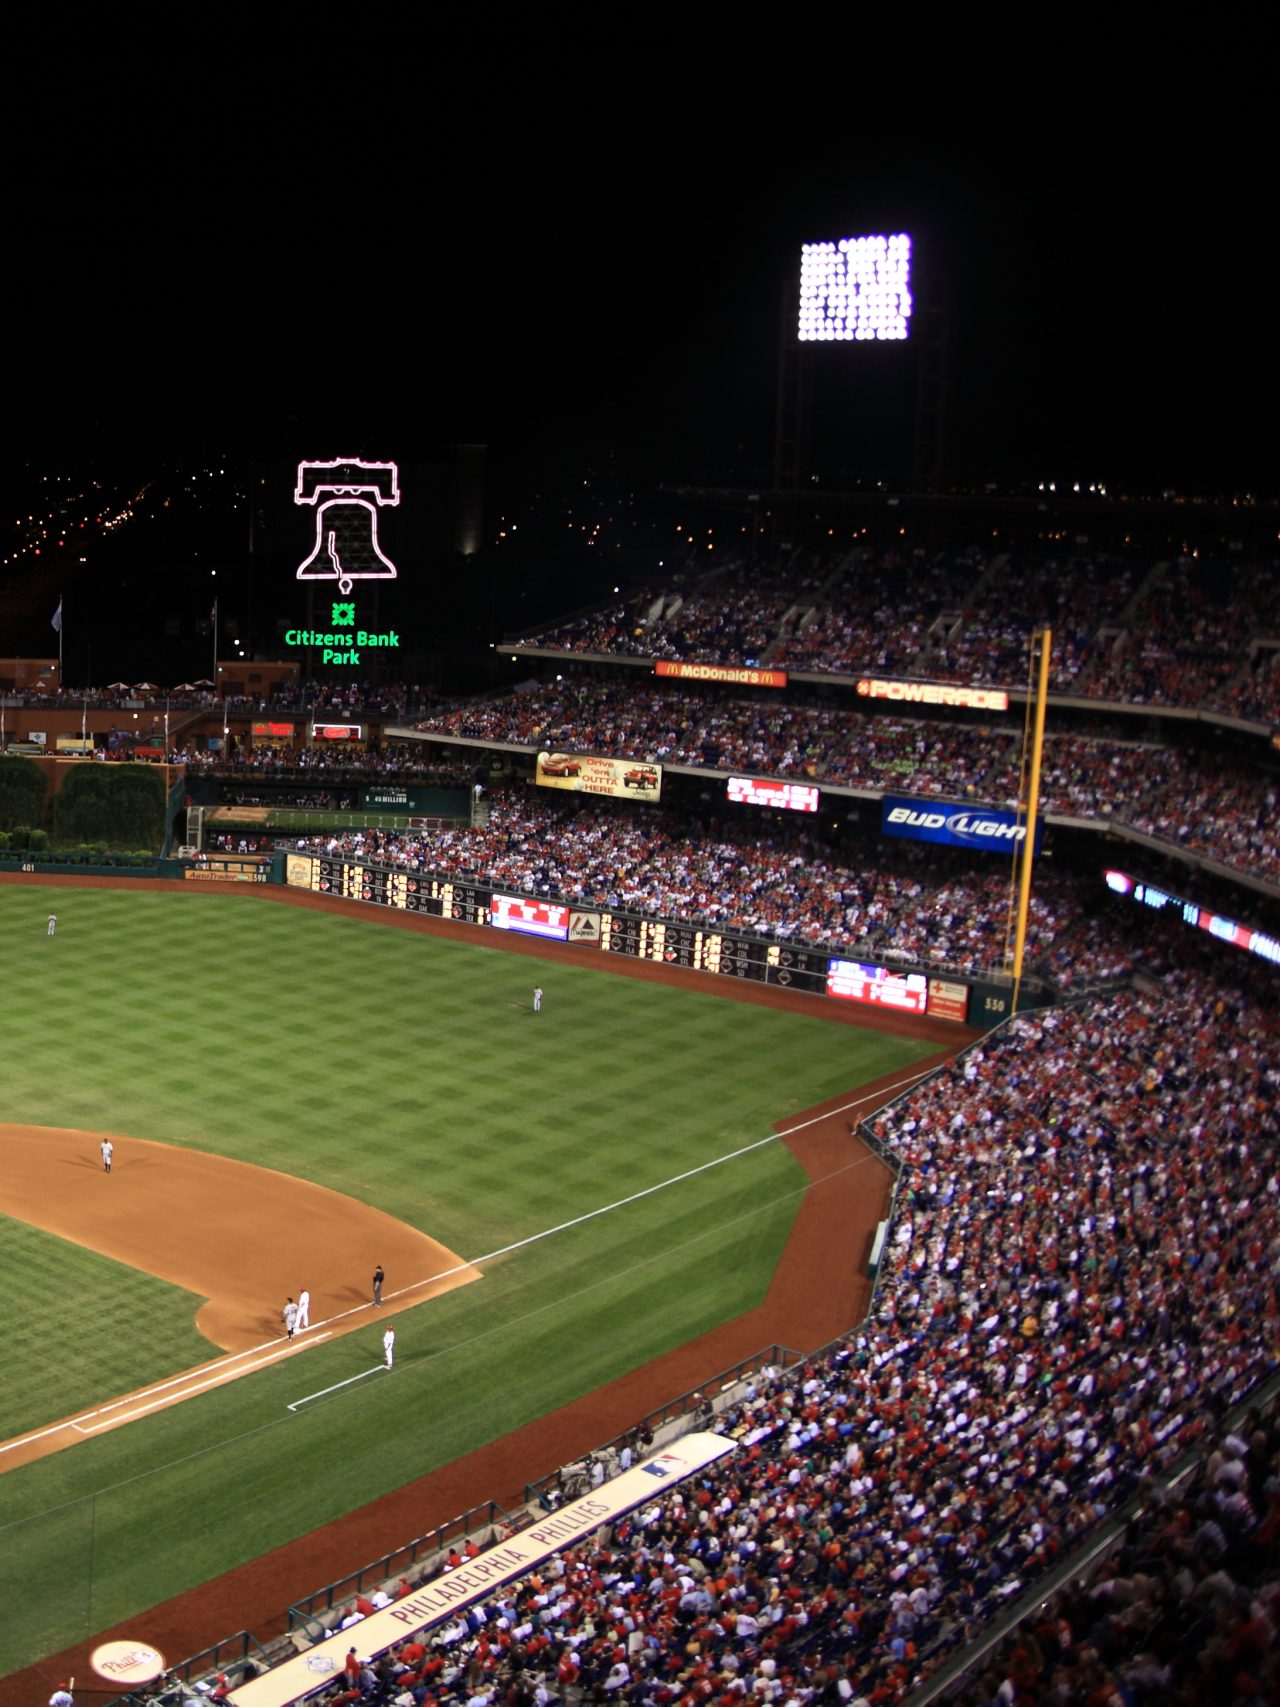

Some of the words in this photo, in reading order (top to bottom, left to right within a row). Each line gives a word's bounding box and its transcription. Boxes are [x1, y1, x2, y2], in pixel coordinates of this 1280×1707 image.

[286, 630, 354, 646] Citizens
[357, 631, 400, 646] Bank
[323, 649, 360, 664] Park
[681, 664, 759, 682] McDonald's
[871, 680, 1008, 710] POWERADE
[587, 757, 615, 769] Drive
[582, 775, 618, 785] OUTTA
[584, 784, 614, 795] HERE
[887, 808, 946, 828] BUD
[22, 863, 35, 872] 401
[985, 998, 1005, 1012] 330
[389, 1548, 529, 1626] PHILADELPHIA
[528, 1500, 610, 1546] PHILLIES
